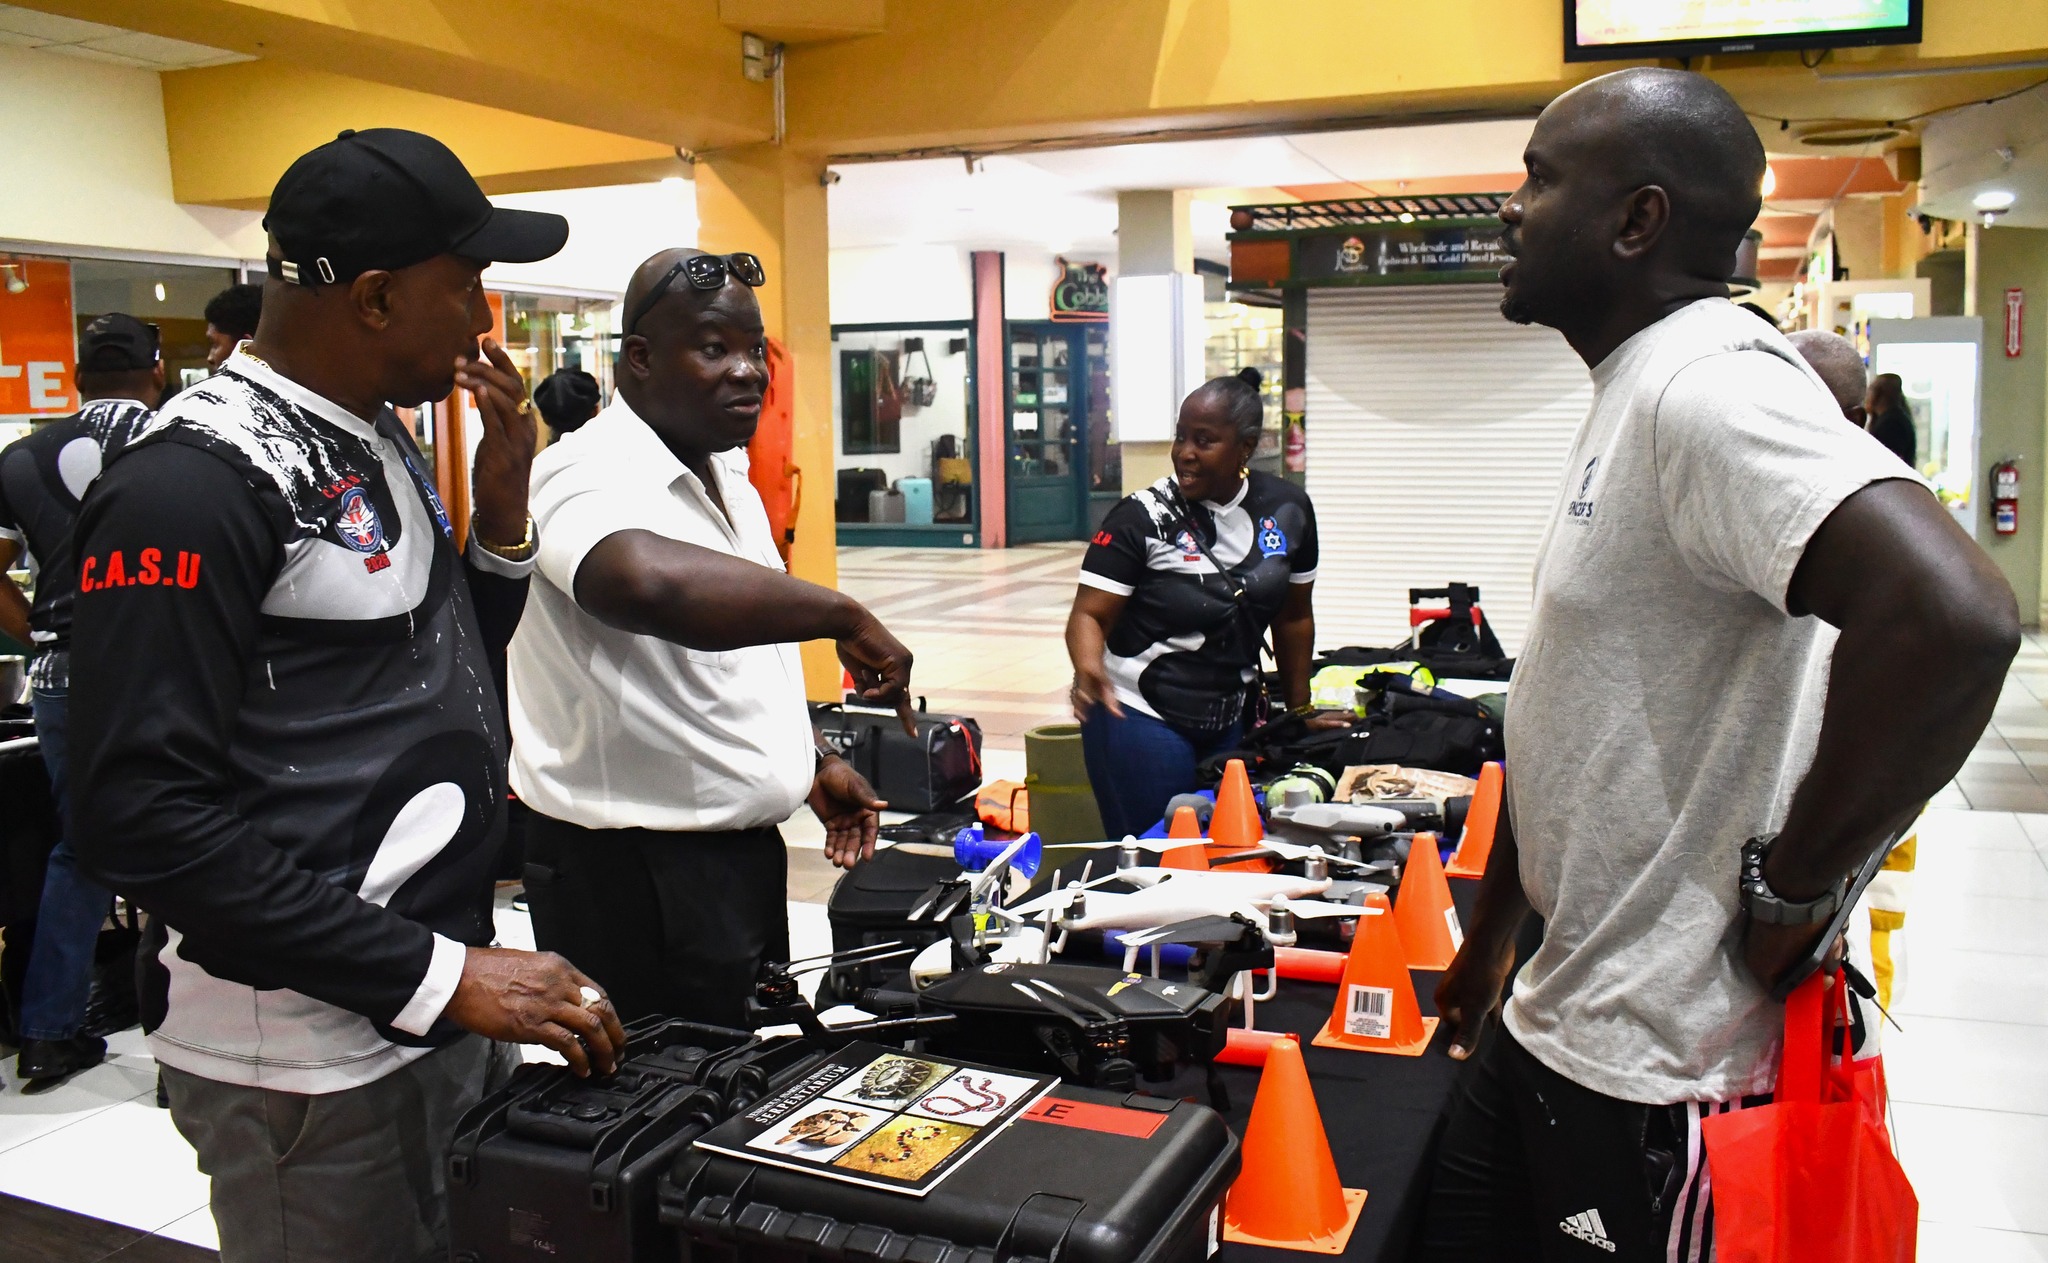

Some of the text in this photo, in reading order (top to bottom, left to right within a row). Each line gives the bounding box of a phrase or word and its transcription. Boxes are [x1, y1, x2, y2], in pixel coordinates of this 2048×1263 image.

[1449, 240, 1470, 252] and
[1056, 282, 1108, 311] Cobb
[81, 547, 201, 593] C.A.S.U
[754, 1065, 850, 1124] SERPENTARIUM
[1559, 1221, 1616, 1253] adidas
